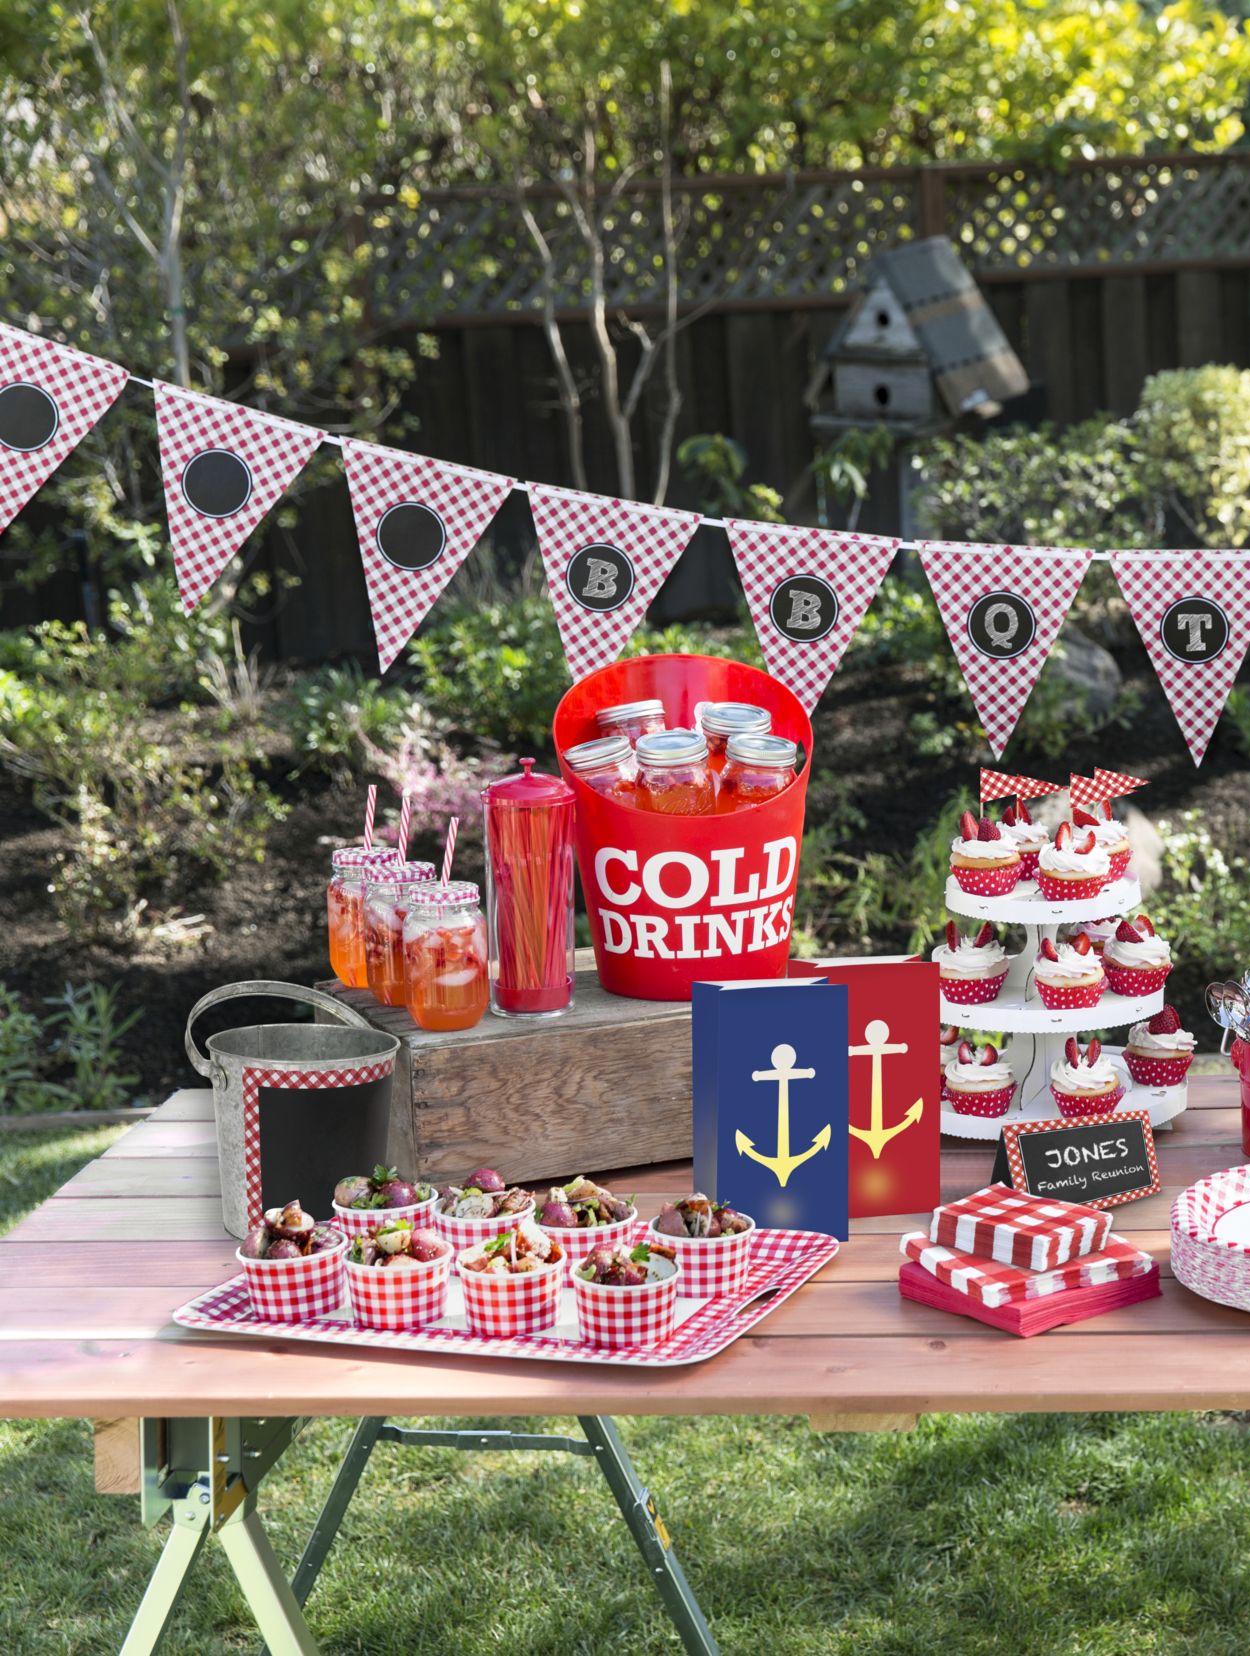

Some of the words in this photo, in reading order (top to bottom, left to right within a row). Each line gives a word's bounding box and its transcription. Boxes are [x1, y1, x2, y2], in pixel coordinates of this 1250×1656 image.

[582, 558, 618, 598] B
[787, 590, 821, 629] B
[985, 603, 1018, 649] Q
[1178, 614, 1212, 651] T
[594, 836, 797, 909] COLD
[598, 894, 794, 960] DRINKS
[1038, 1175, 1087, 1190] Family
[1092, 1165, 1144, 1181] Reunion
[1044, 1138, 1129, 1168] JONES
